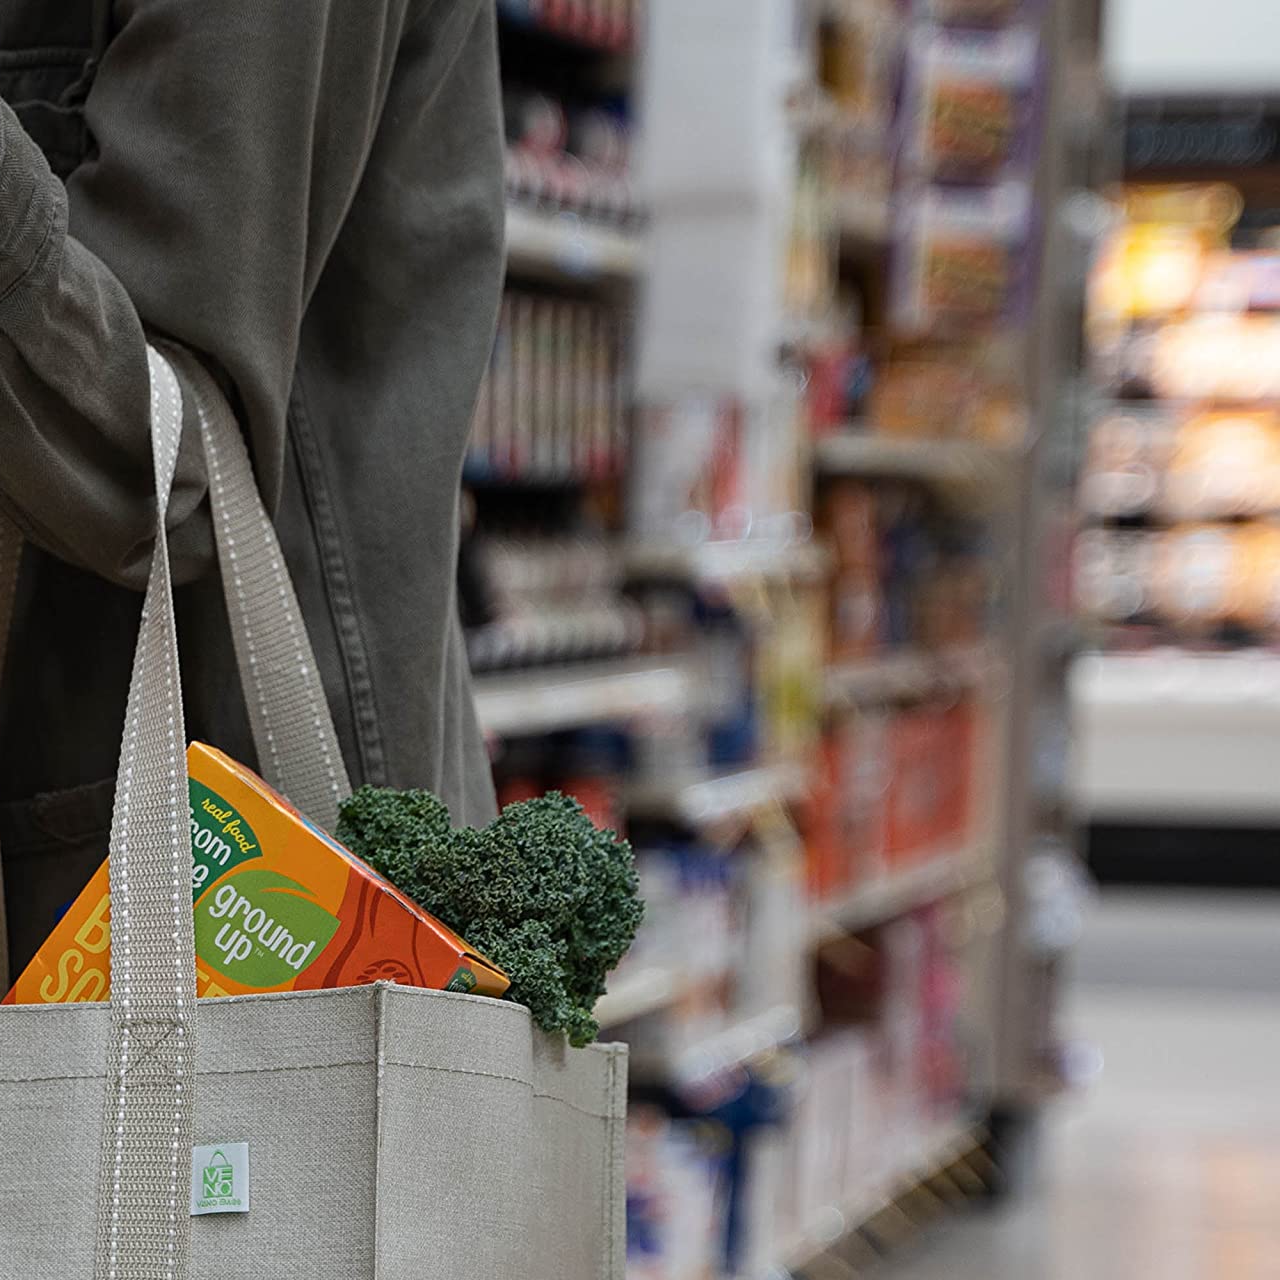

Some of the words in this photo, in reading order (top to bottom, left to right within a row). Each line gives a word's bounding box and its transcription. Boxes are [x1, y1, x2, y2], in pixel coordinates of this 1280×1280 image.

[200, 797, 233, 824] real
[222, 818, 257, 854] food
[208, 884, 317, 971] ground
